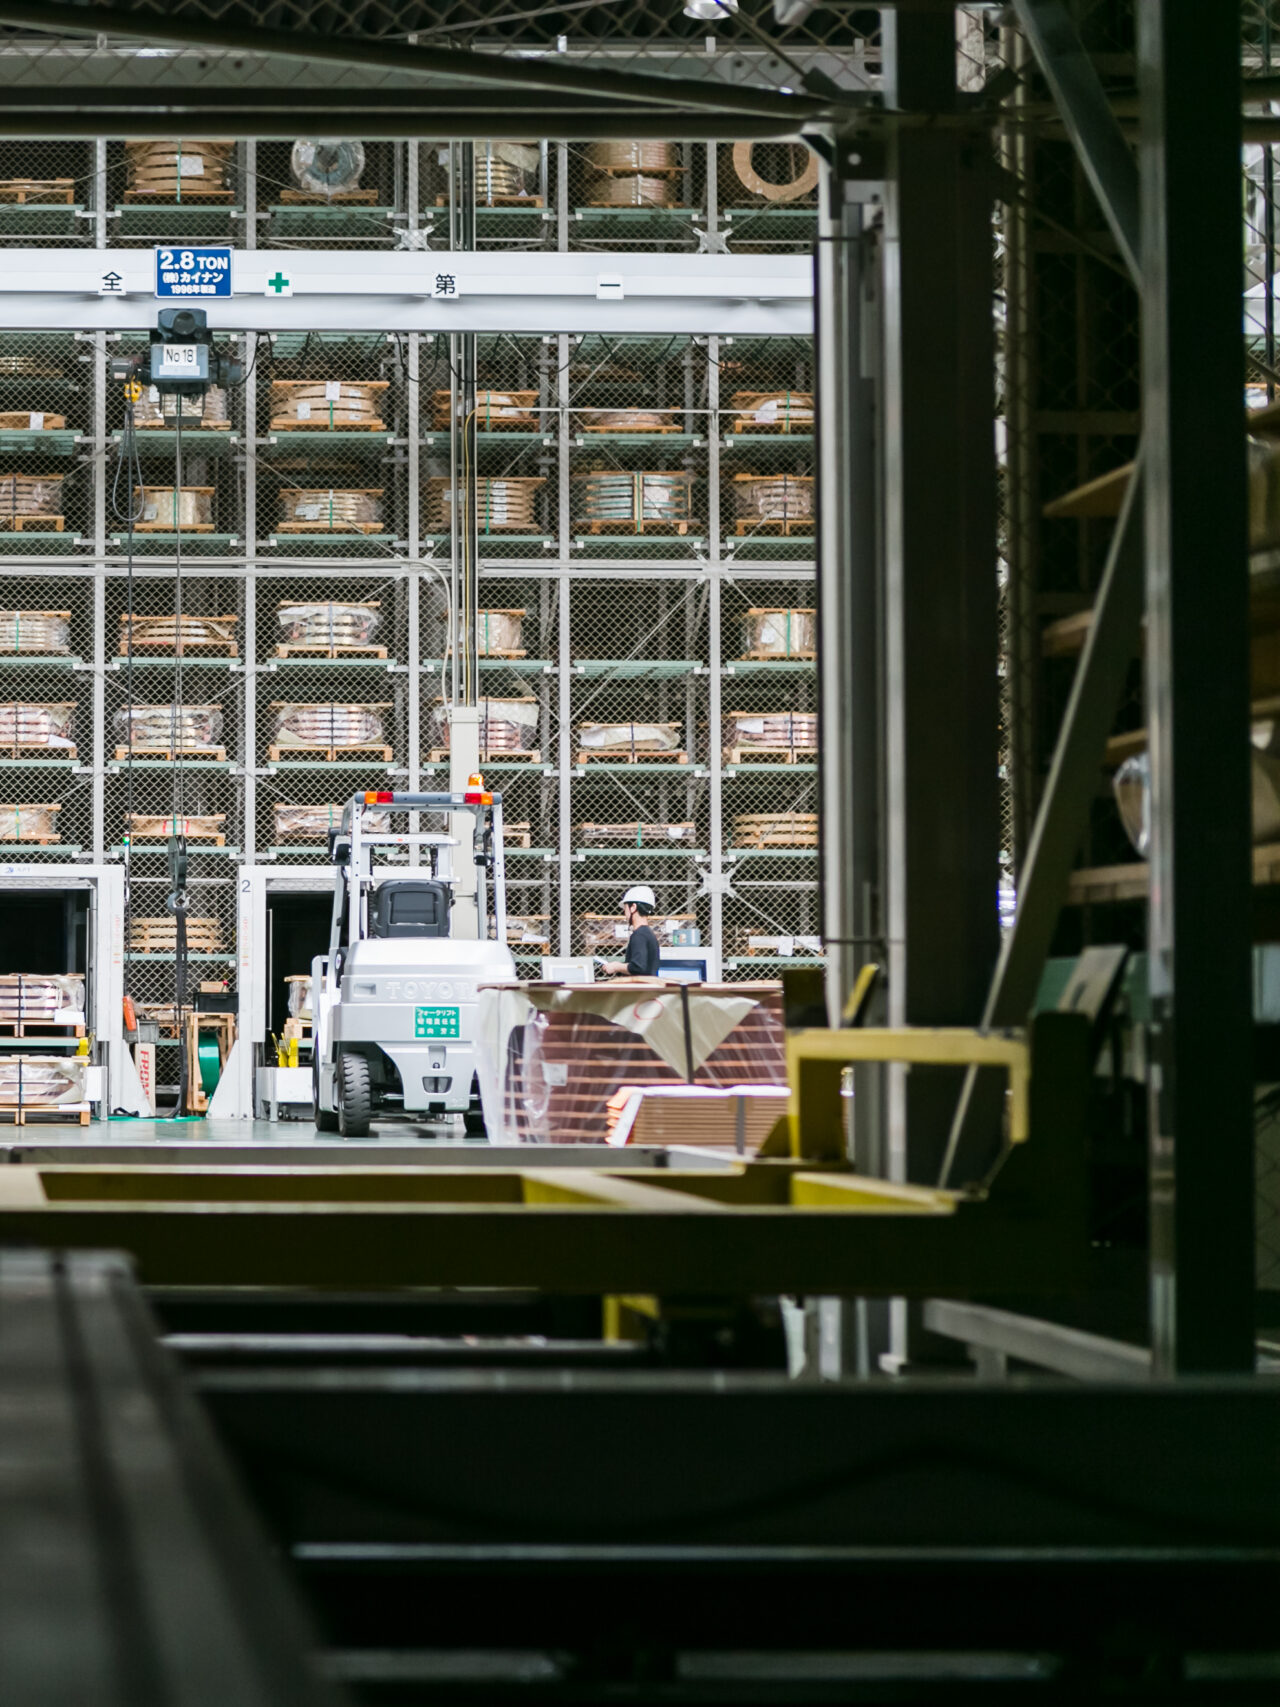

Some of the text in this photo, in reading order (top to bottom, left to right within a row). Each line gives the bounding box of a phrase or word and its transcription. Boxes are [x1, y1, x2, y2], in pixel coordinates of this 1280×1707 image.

[160, 251, 228, 270] 2.8 TON
[102, 271, 122, 291] 全
[435, 274, 456, 294] 第
[183, 349, 193, 362] 18
[241, 879, 251, 893] 2
